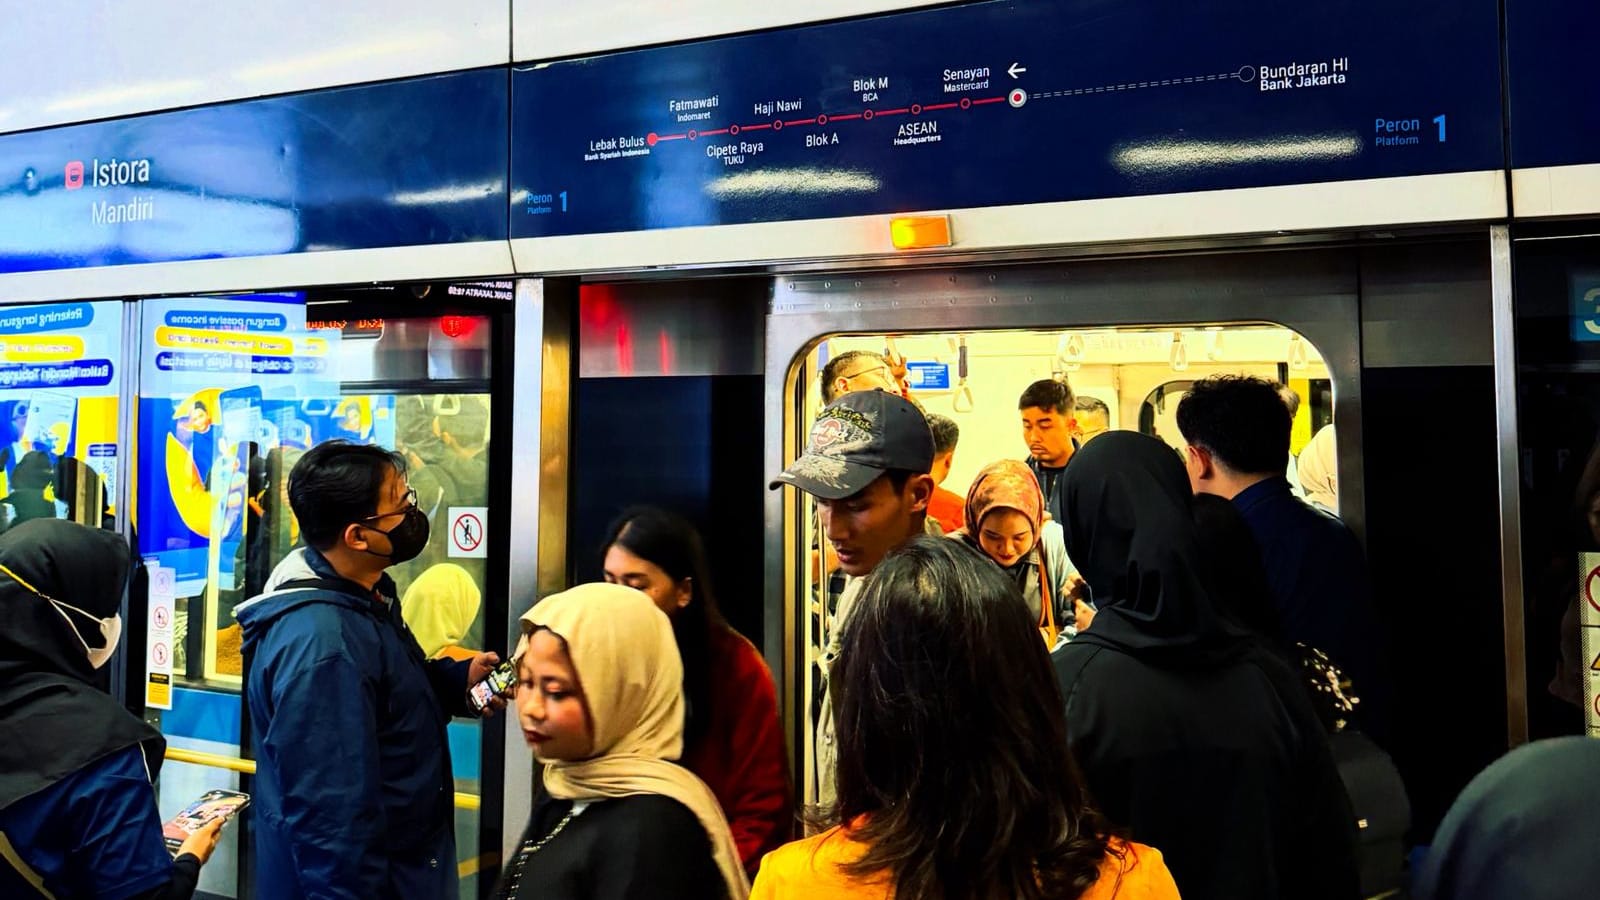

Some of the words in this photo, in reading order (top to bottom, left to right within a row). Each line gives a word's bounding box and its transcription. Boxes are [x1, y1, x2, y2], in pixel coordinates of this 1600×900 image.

[943, 67, 990, 83] Senayan
[1260, 62, 1328, 80] Bundaran
[1333, 57, 1348, 72] HI
[853, 78, 875, 92] Blok
[878, 77, 888, 89] M
[944, 79, 989, 93] Mastercard
[1260, 78, 1292, 91] Bank
[1296, 73, 1346, 88] Jakarta
[669, 95, 719, 112] Fatmawati
[863, 93, 878, 102] BCA
[754, 101, 774, 117] Haji
[777, 98, 802, 113] Nawi
[677, 111, 711, 122] Indomaret
[898, 121, 937, 137] ASEAN
[1375, 118, 1420, 133] Peron
[1433, 114, 1446, 142] 1
[590, 138, 617, 151] Lebak
[619, 135, 645, 149] Bulus
[806, 133, 828, 147] Blok
[830, 132, 839, 145] A
[893, 133, 942, 146] Headquarters
[1375, 136, 1419, 147] Platform
[600, 151, 621, 160] Syariah
[622, 148, 650, 157] Indonesia
[706, 144, 738, 159] Cipete
[740, 142, 764, 158] Raya
[724, 155, 744, 166] TUKU
[92, 158, 150, 188] Istora
[527, 193, 552, 204] Peron
[559, 191, 567, 212] 1
[92, 197, 153, 225] Mandiri
